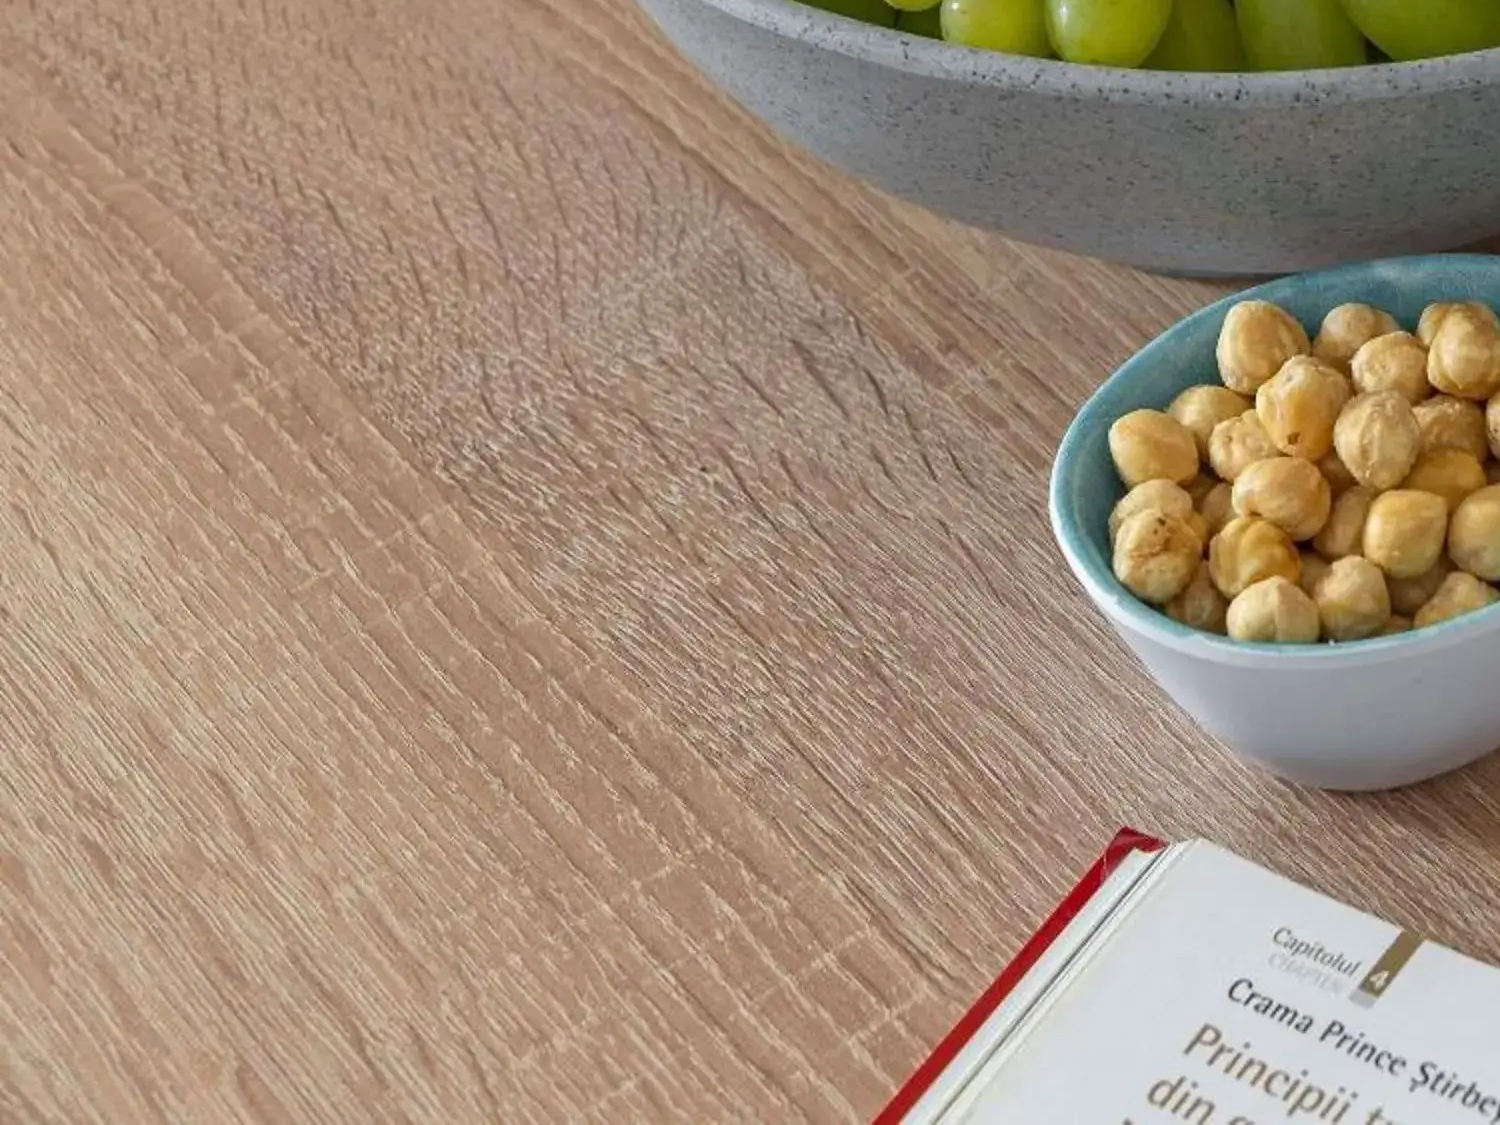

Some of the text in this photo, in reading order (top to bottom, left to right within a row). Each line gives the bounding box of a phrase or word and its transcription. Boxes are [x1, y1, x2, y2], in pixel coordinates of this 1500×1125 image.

[1271, 926, 1390, 988] Capitolul 4
[1183, 1022, 1360, 1125] Principii
[1227, 977, 1315, 1036] Crama
[1318, 1018, 1408, 1077] Prince
